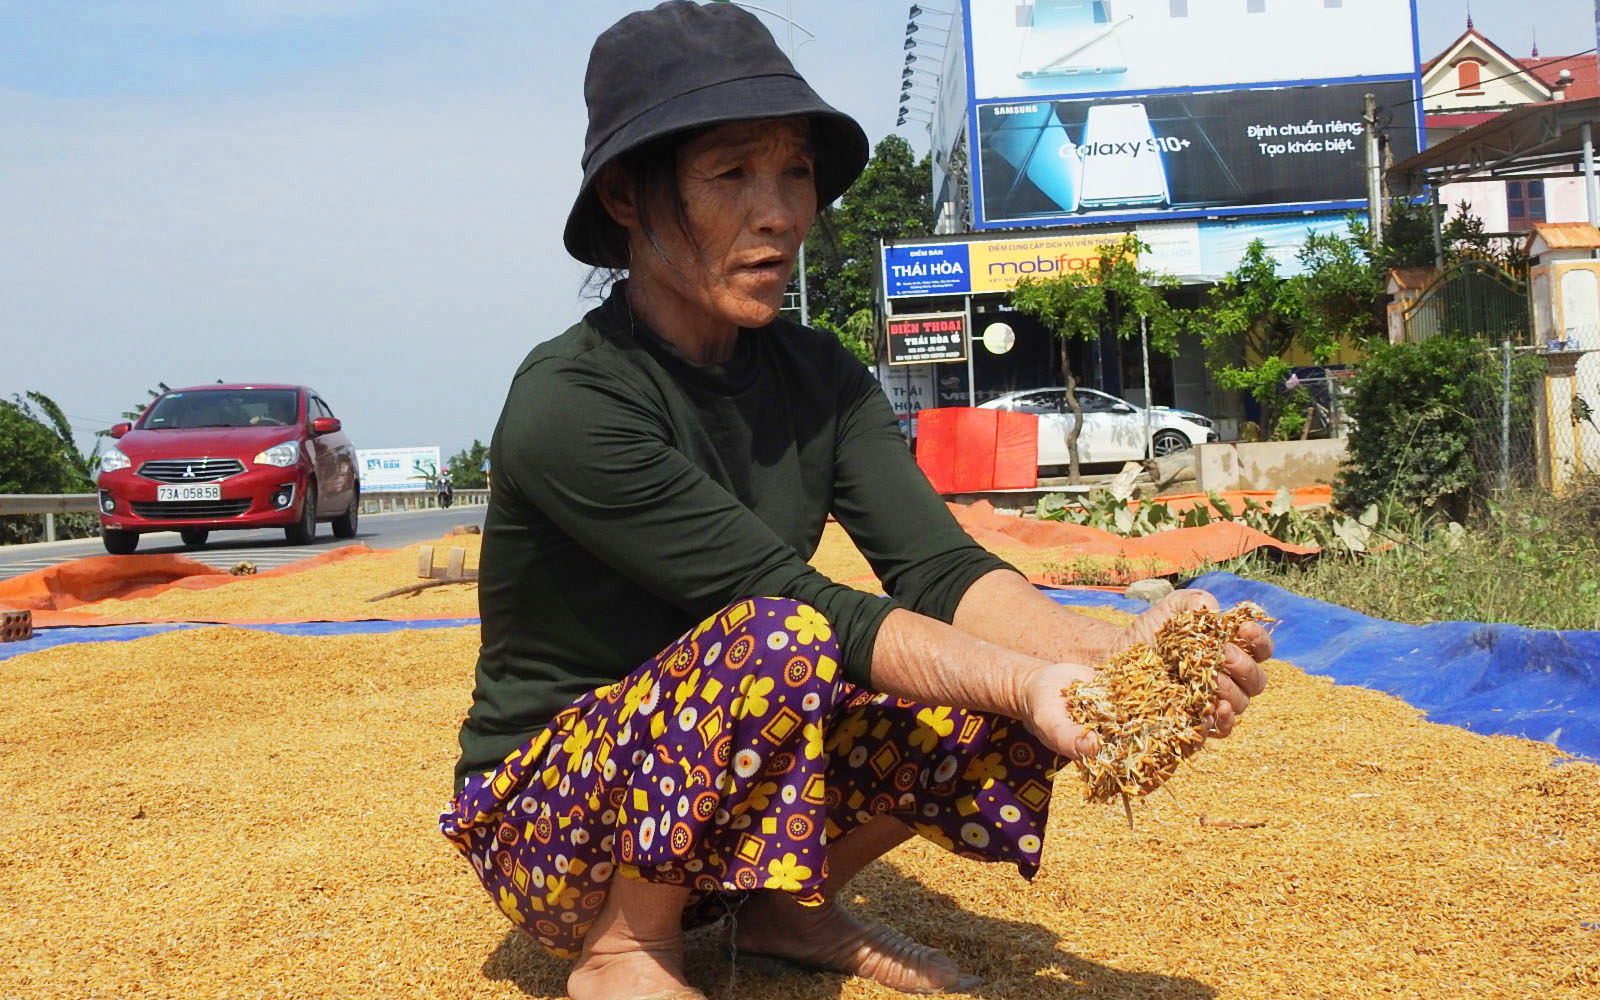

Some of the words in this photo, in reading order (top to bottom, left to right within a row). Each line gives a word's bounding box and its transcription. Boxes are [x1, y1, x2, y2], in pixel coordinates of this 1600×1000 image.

[994, 104, 1038, 116] SAMSUNG
[1246, 124, 1278, 141] Định
[1280, 119, 1323, 136] chuẩn
[1325, 119, 1365, 136] riêng.
[1059, 141, 1142, 158] Galaxy
[1145, 136, 1191, 153] S10+
[1258, 142, 1286, 158] Tạo
[1287, 139, 1323, 153] khác
[1324, 137, 1356, 154] biệt.
[891, 261, 928, 278] THÁI
[930, 259, 964, 276] HÒA
[890, 320, 920, 336] ĐIỆN
[922, 320, 962, 334] THOẠI
[904, 334, 928, 346] THÁI
[929, 333, 950, 345] HÒA
[160, 487, 219, 500] 73A-058.58
